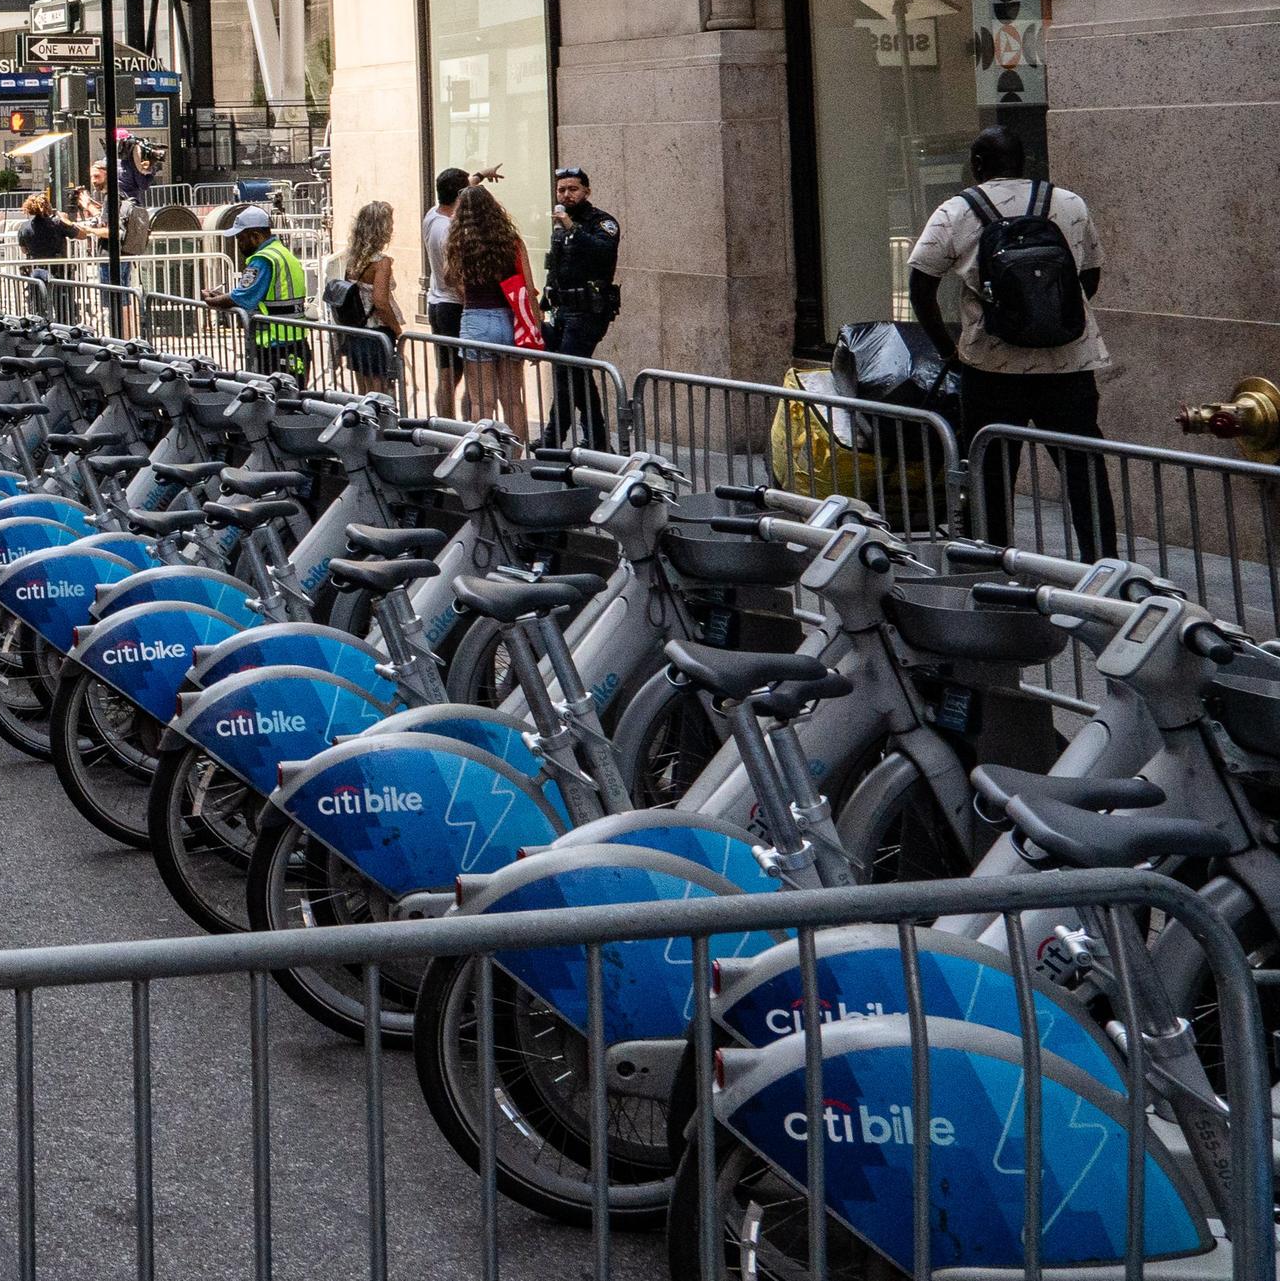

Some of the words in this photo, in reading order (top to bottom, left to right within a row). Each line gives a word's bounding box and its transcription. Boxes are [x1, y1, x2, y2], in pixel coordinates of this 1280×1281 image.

[39, 45, 58, 54] ONE
[68, 45, 90, 54] WAY
[115, 57, 164, 71] STATION
[16, 584, 44, 601] citi
[47, 580, 85, 598] bike
[102, 644, 138, 665] citi
[140, 640, 186, 660] bike
[216, 715, 253, 738] citi
[257, 710, 306, 734] bike
[318, 790, 361, 815] citi
[365, 786, 423, 812] bike
